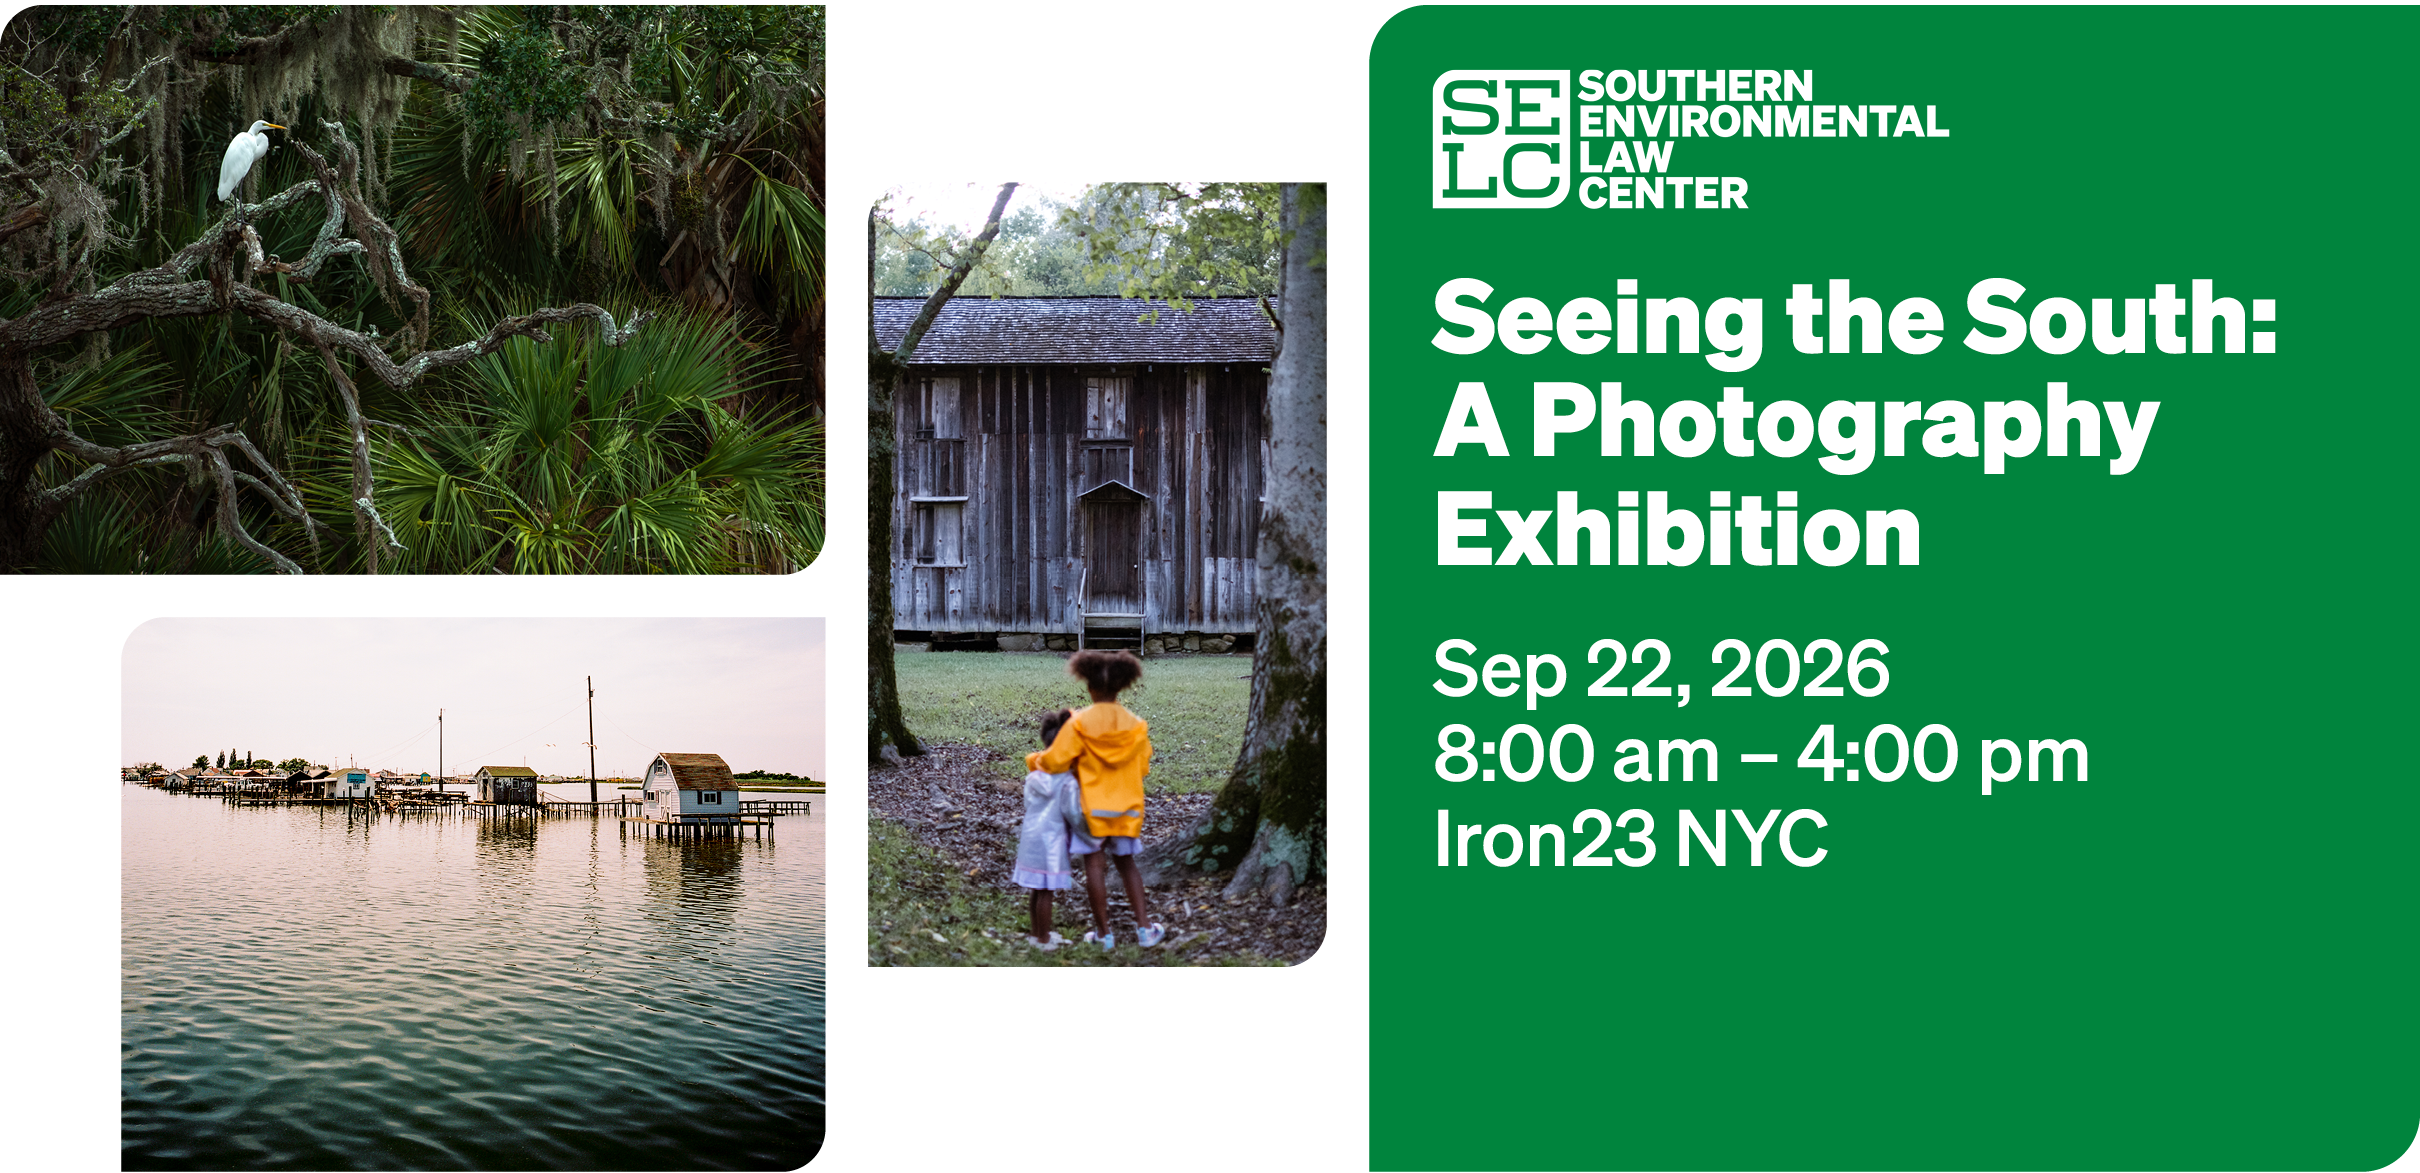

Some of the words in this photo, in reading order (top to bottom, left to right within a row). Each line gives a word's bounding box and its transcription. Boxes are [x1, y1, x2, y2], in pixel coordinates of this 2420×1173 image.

[1578, 70, 1812, 101] SOUTHERN
[1580, 105, 1949, 137] ENVIRONMENTAL
[1580, 141, 1674, 172] LAW
[1579, 177, 1748, 209] CENTER
[1431, 278, 1762, 372] Seeing
[1786, 279, 1944, 354] the
[1963, 278, 2275, 354] South:
[1433, 382, 1510, 456] A
[1534, 382, 2161, 475] Photography
[1438, 491, 1919, 566] Exhibition
[1433, 639, 1566, 710] Sep
[1588, 639, 1690, 707] 22,
[1712, 639, 1889, 697] 2026
[1435, 724, 1594, 782] 8:00
[1614, 739, 1717, 782] am
[1798, 724, 1958, 782] 4:00
[1982, 739, 2087, 795] pm
[1438, 809, 1656, 867] Iron23
[1679, 809, 1828, 867] NYC
